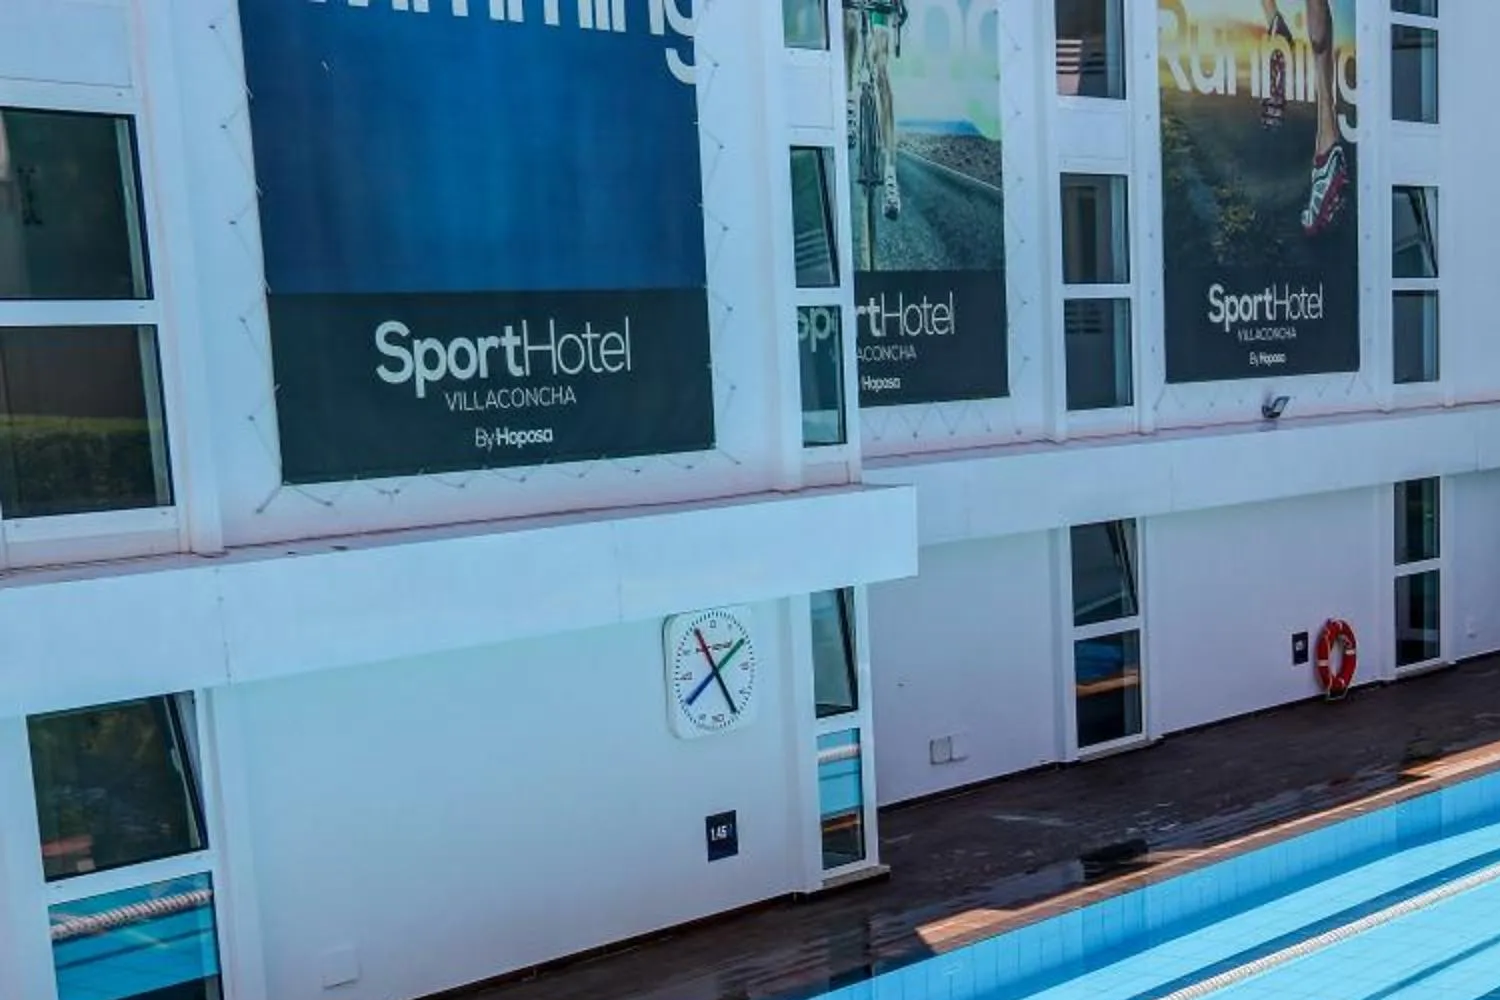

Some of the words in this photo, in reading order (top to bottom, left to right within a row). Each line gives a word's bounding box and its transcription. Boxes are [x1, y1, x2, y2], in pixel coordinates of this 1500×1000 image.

[1208, 282, 1323, 332] SportHotel
[375, 316, 631, 398] SportHotel
[444, 385, 577, 412] VILLACONCHA
[496, 426, 553, 448] Hoposa
